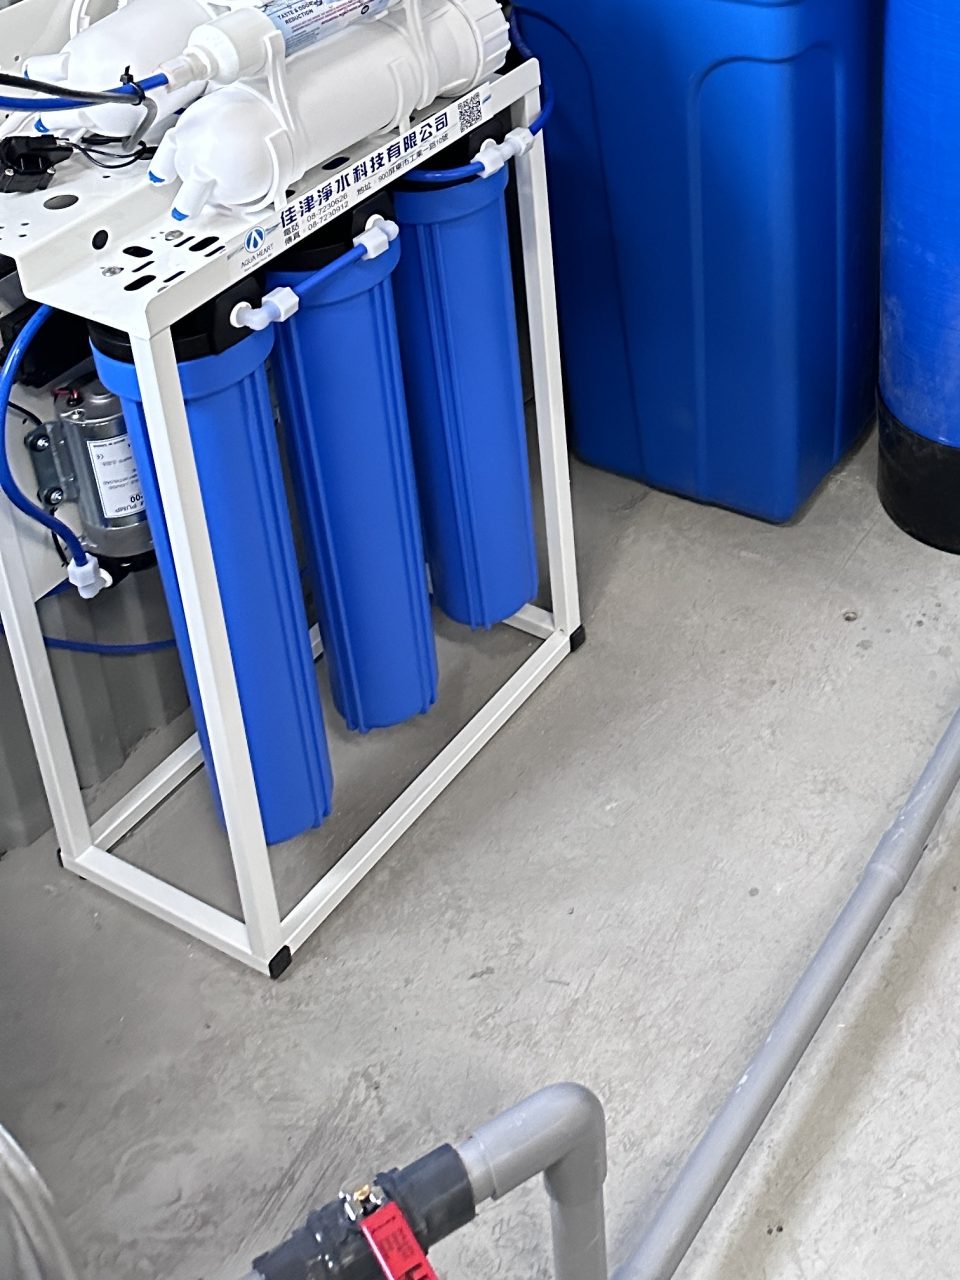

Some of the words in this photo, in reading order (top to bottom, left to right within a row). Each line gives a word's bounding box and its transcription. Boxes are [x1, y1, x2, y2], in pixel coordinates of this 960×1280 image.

[278, 10, 295, 20] TASTE
[284, 8, 314, 25] REDUCTION
[280, 112, 448, 228] 佳津淨水科技有限公司
[241, 255, 255, 269] AQUA
[257, 243, 273, 259] HEART
